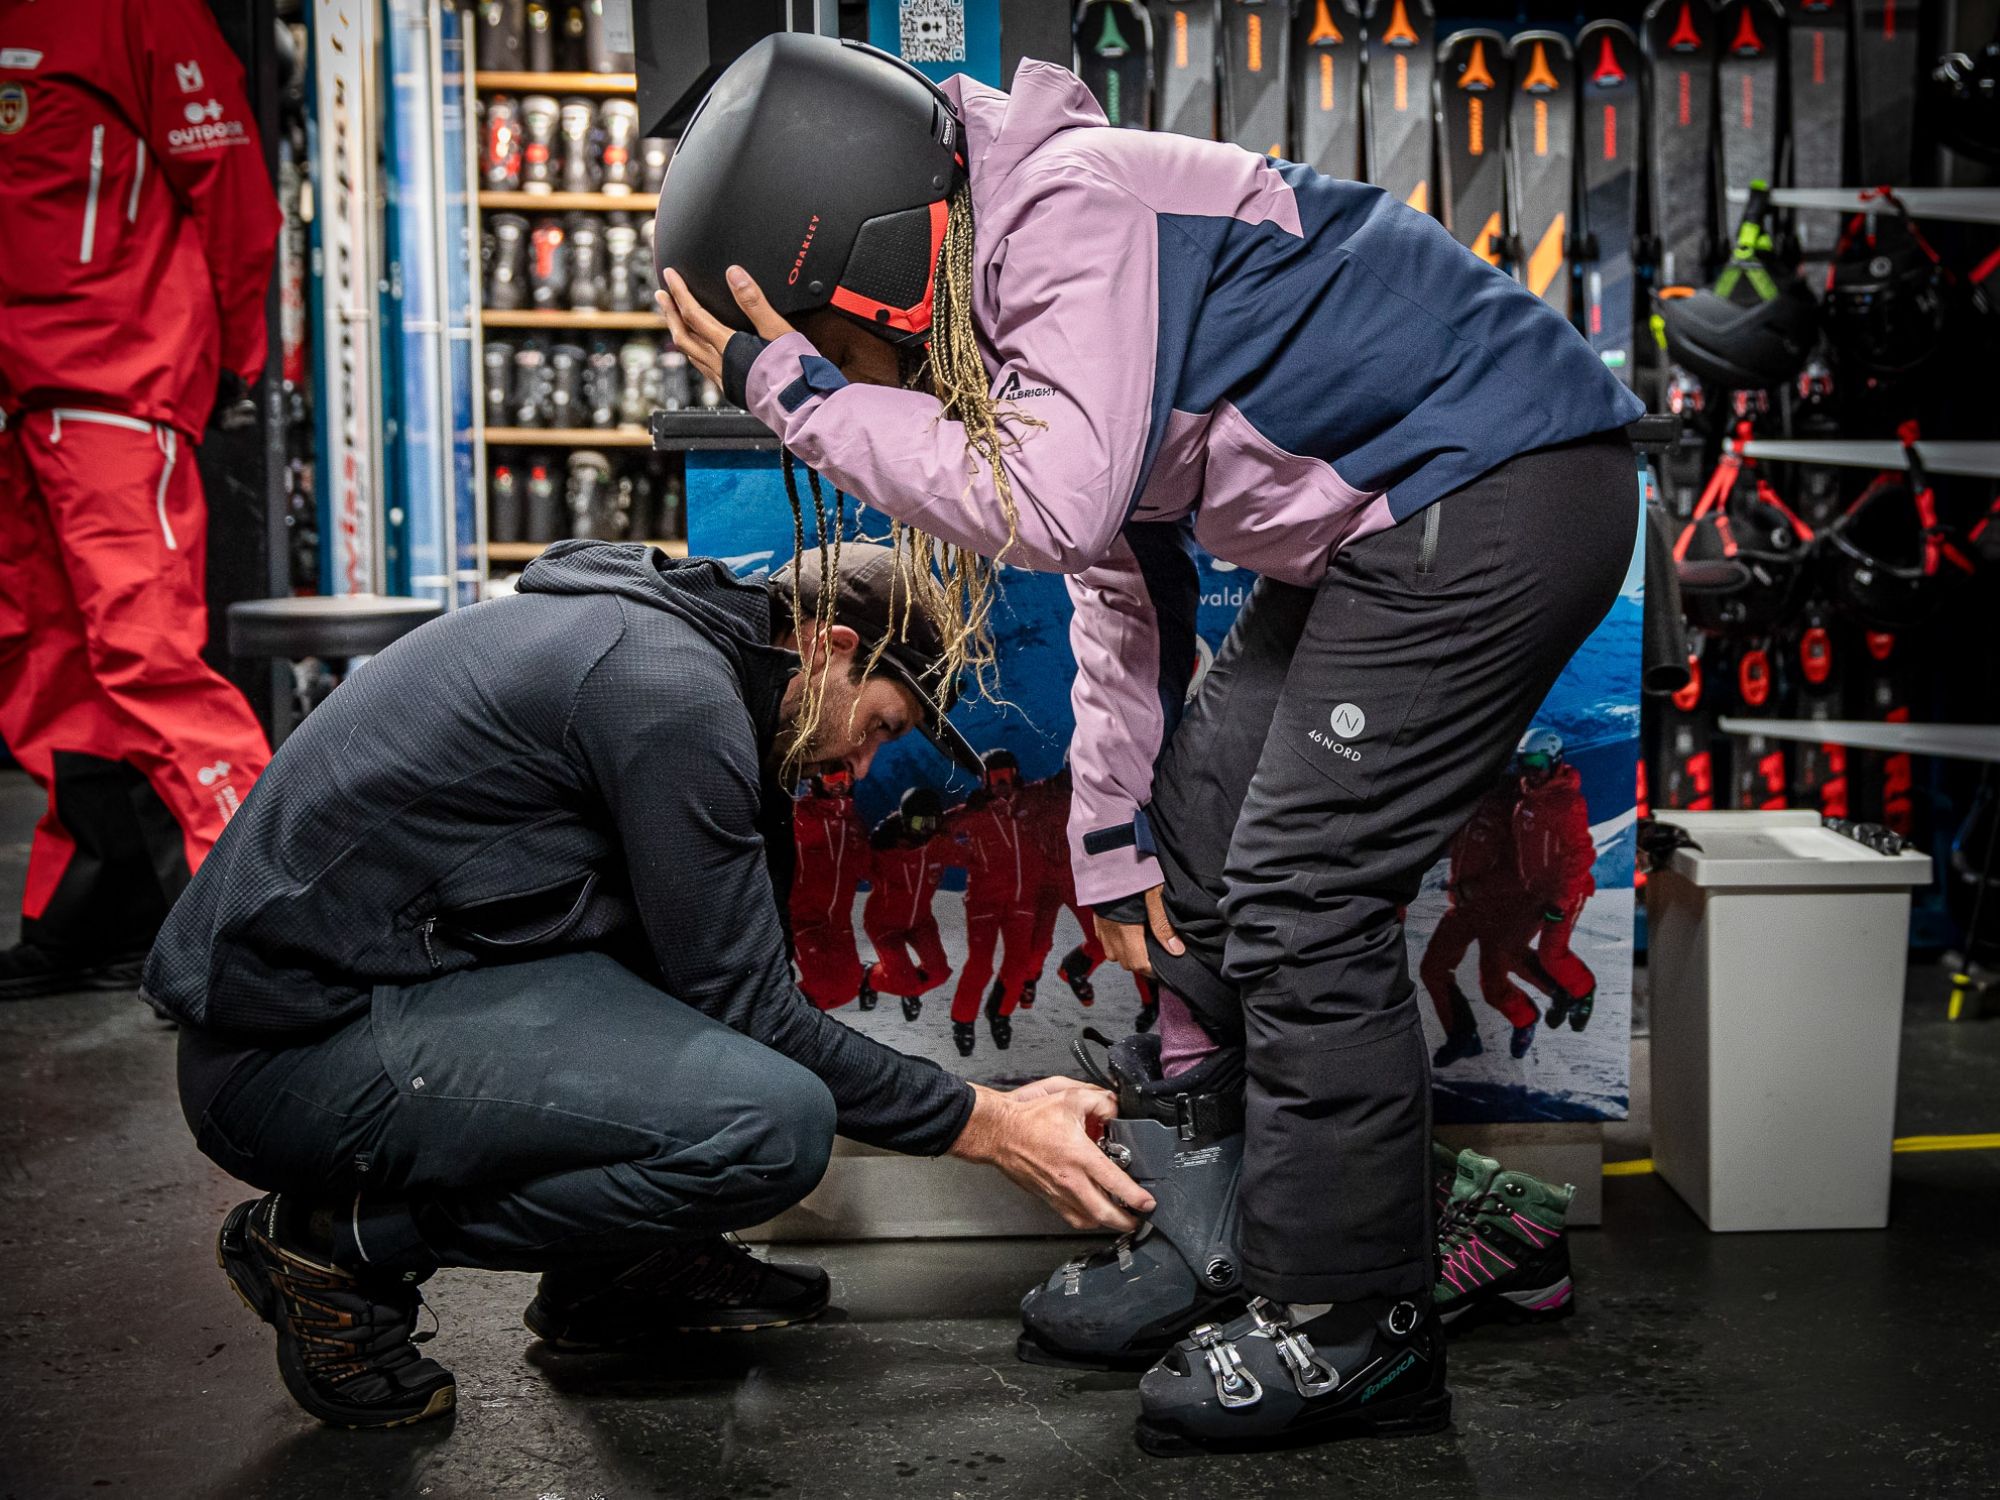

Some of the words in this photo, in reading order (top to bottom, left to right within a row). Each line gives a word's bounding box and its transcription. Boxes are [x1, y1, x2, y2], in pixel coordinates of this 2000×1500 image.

[1006, 387, 1056, 400] ALBRIGHT
[1308, 729, 1322, 742] 46
[1322, 736, 1361, 761] NORD
